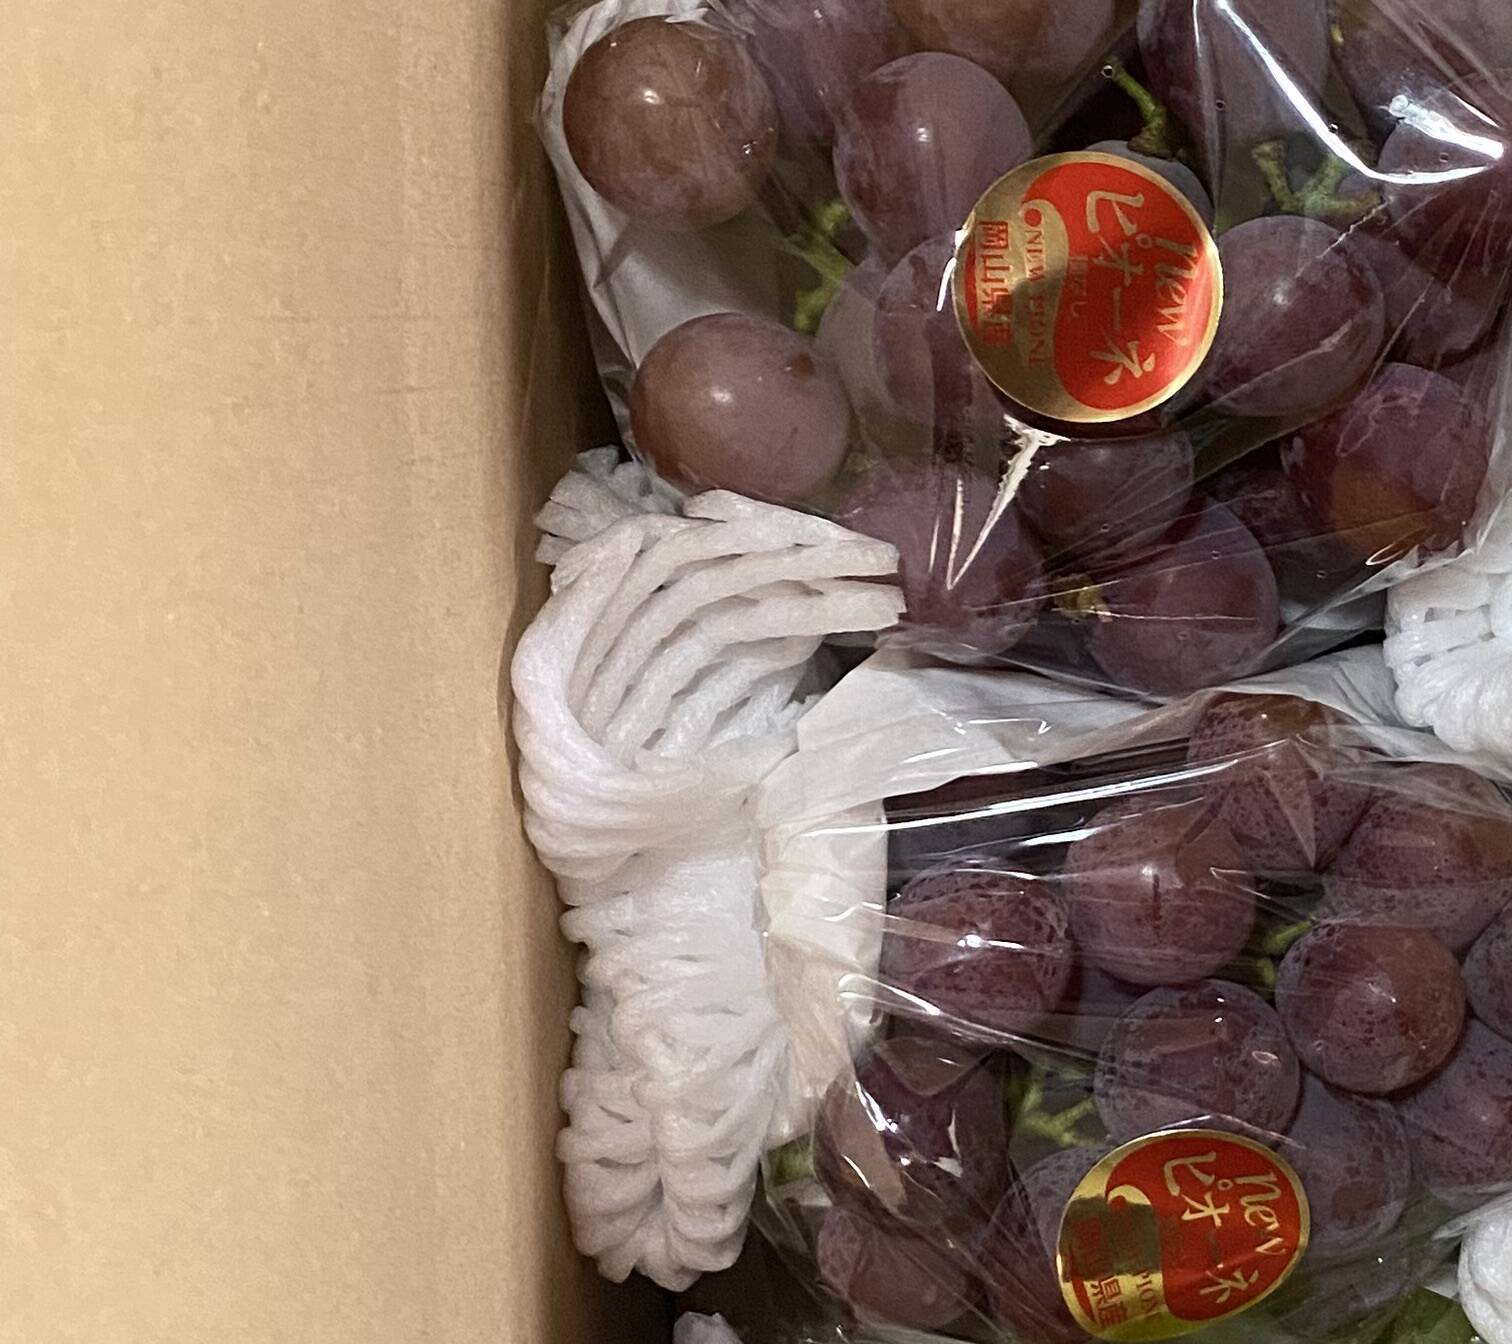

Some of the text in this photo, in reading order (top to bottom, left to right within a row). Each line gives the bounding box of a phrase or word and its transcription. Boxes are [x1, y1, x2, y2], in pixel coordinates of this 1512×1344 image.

[1026, 226, 1044, 284] NEW
[1086, 190, 1155, 384] ピオーネ
